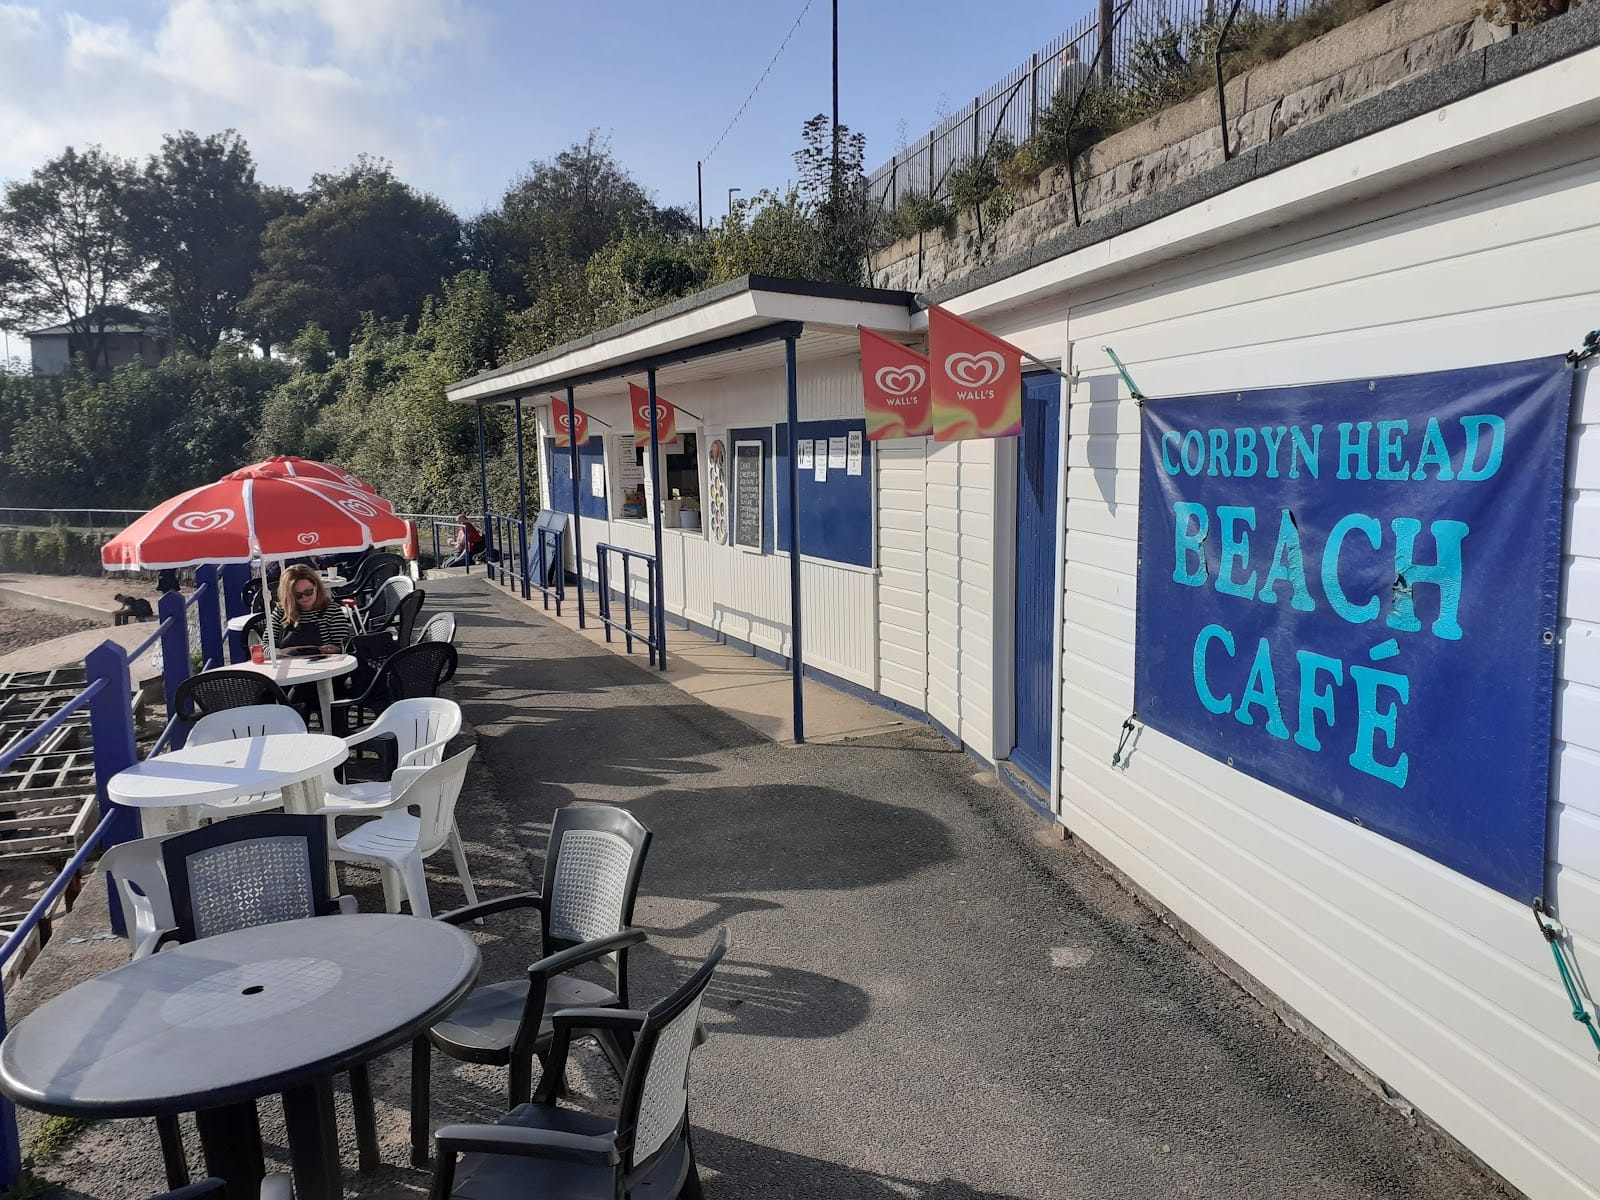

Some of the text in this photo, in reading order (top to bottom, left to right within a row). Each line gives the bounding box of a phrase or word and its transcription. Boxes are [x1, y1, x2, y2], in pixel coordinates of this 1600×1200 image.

[886, 396, 918, 406] WALL'S
[957, 390, 994, 400] WALL'S
[1161, 414, 1506, 482] CORBYN HEAD
[1172, 501, 1470, 640] BEACH
[1192, 624, 1410, 788] CAFÉ
